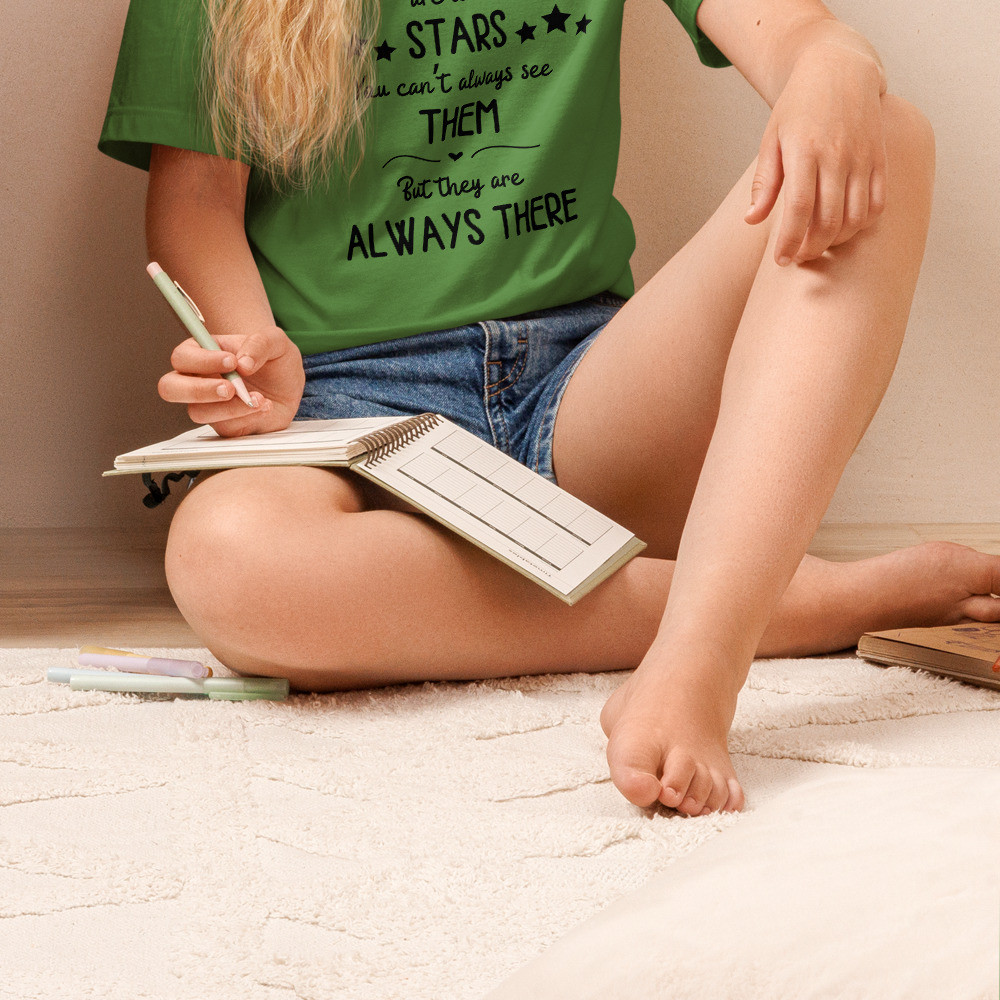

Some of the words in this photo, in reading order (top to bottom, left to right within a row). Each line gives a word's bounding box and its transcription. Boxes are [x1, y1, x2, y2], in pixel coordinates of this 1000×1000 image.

[405, 9, 508, 60] STARS
[396, 63, 453, 97] can't
[458, 66, 513, 92] always
[521, 63, 554, 80] see
[418, 98, 500, 145] THEM
[396, 175, 433, 202] But
[432, 176, 486, 200] they
[490, 172, 525, 189] are
[346, 208, 486, 262] ALWAYS
[492, 187, 579, 240] THERE
